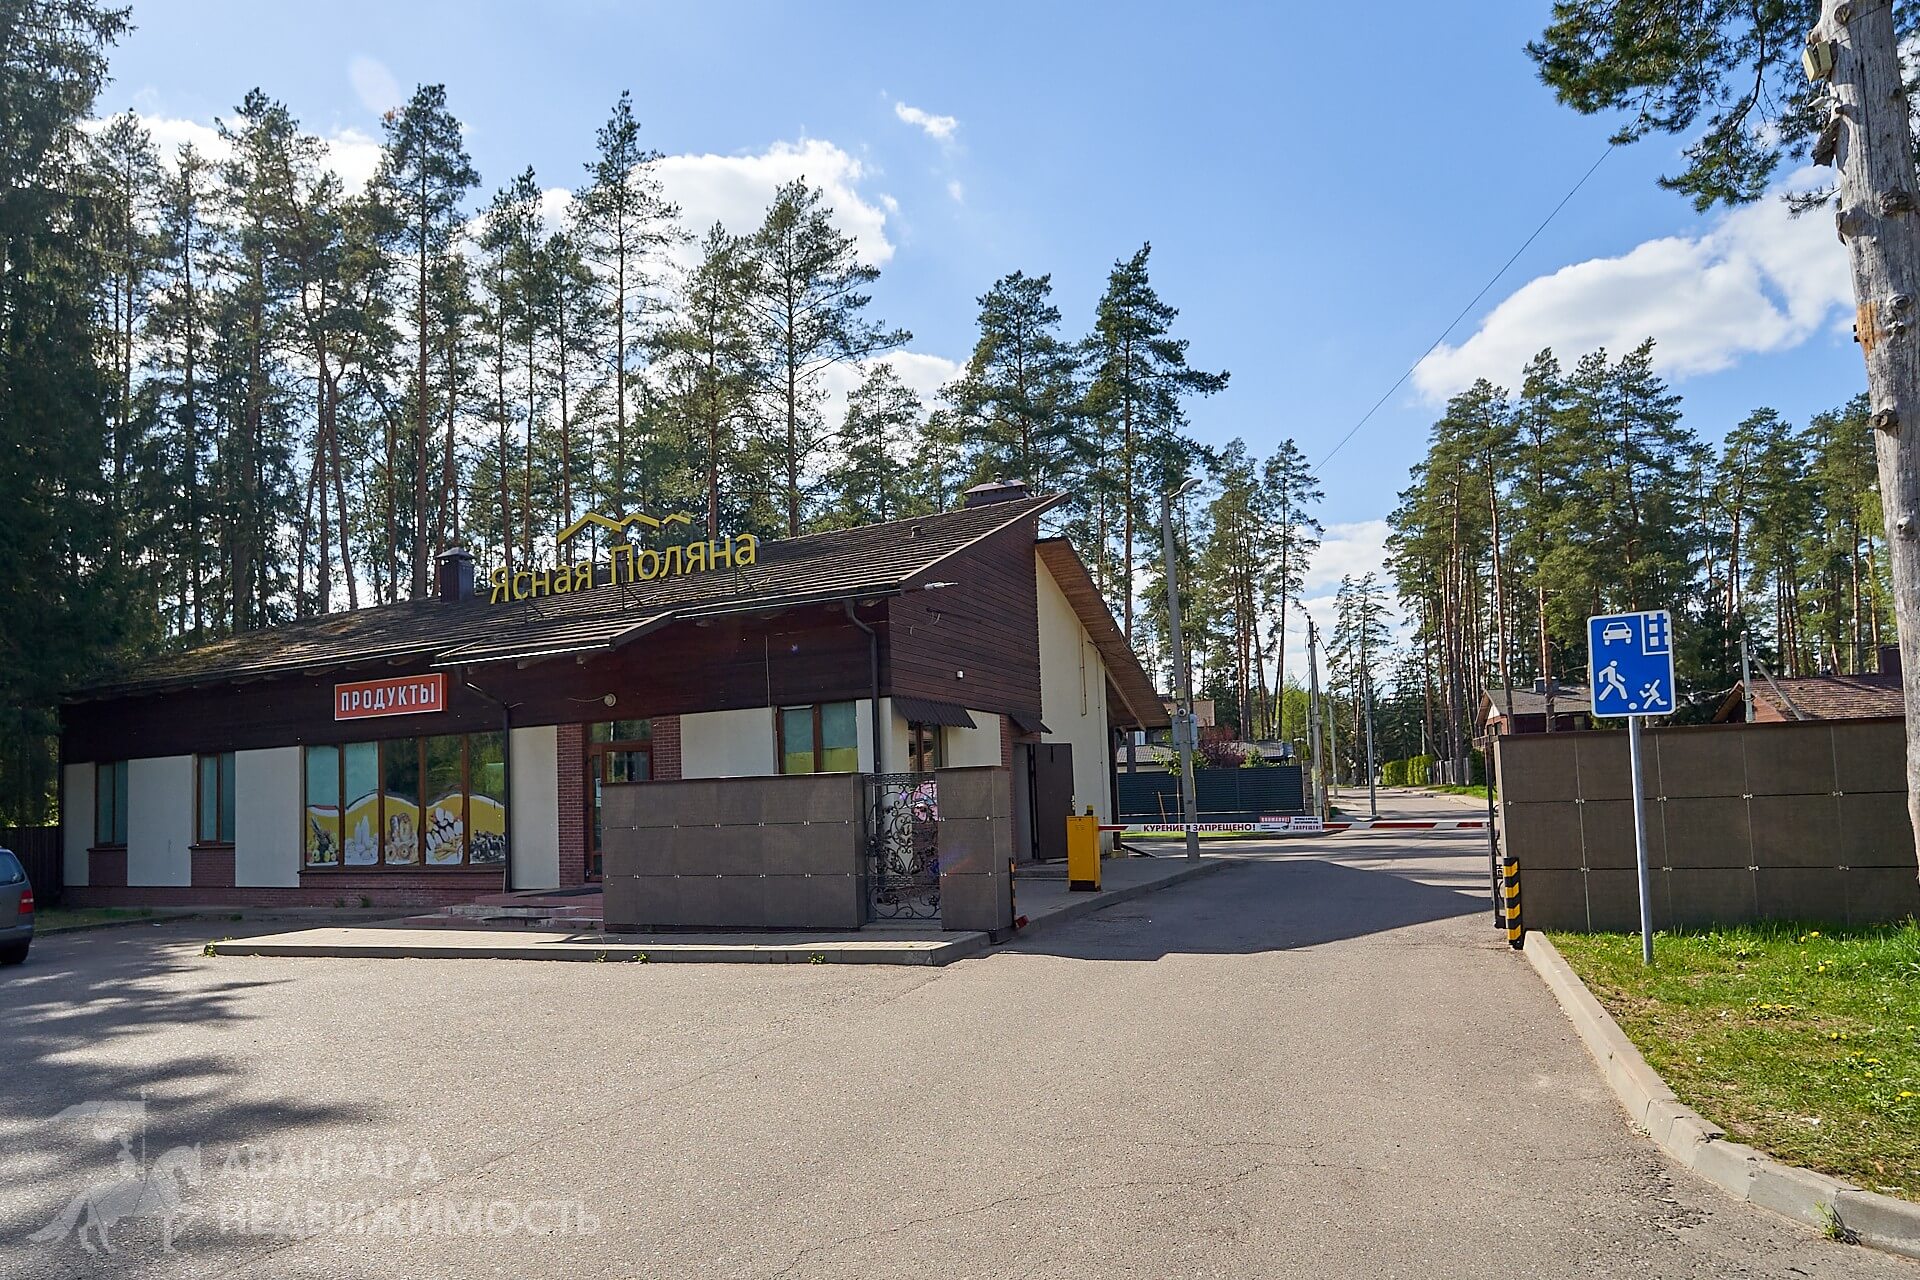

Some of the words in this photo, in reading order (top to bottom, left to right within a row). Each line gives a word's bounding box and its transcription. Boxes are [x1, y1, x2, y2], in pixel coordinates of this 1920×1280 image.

[489, 560, 593, 605] Ясная
[610, 533, 757, 586] Поляна
[341, 682, 435, 711] ПРОДУКТЫ
[1143, 824, 1185, 832] КУРЕНИЕ
[1192, 823, 1256, 832] ЗАПРЕЩЕНО!
